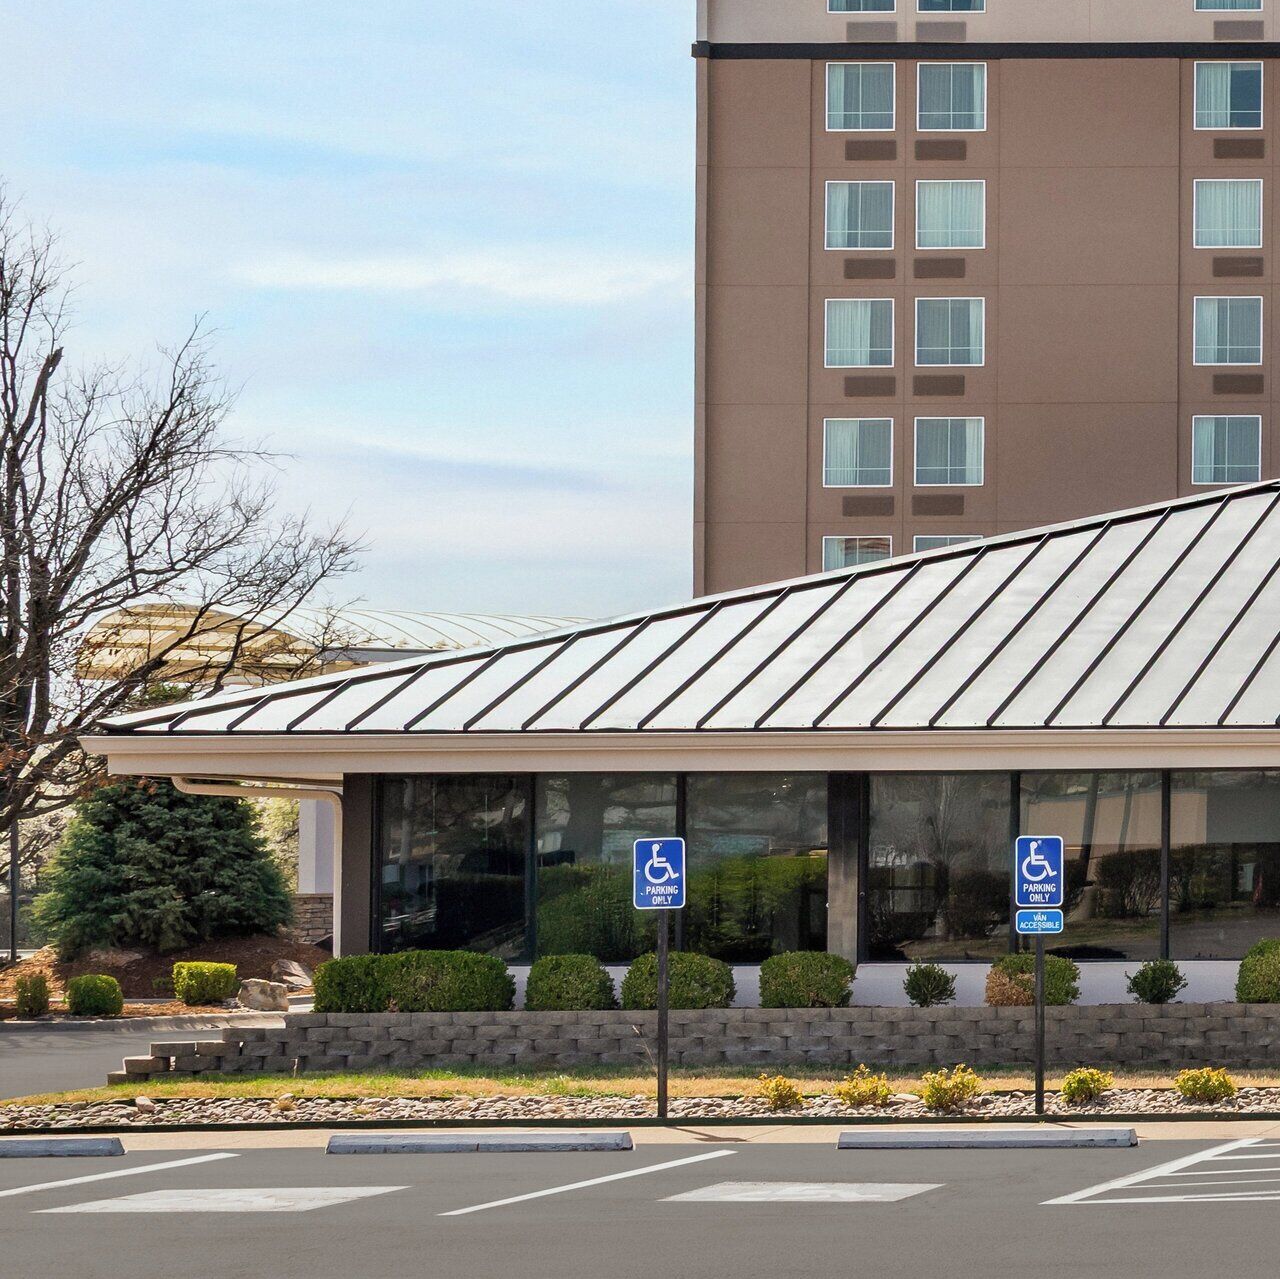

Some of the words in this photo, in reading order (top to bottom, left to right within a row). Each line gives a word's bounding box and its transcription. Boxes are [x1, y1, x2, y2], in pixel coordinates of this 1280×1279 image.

[646, 886, 679, 895] PARKING
[1023, 883, 1056, 893] PARKING
[652, 896, 673, 904] ONLY
[1029, 893, 1050, 902] ONLY
[1033, 914, 1047, 922] VAN
